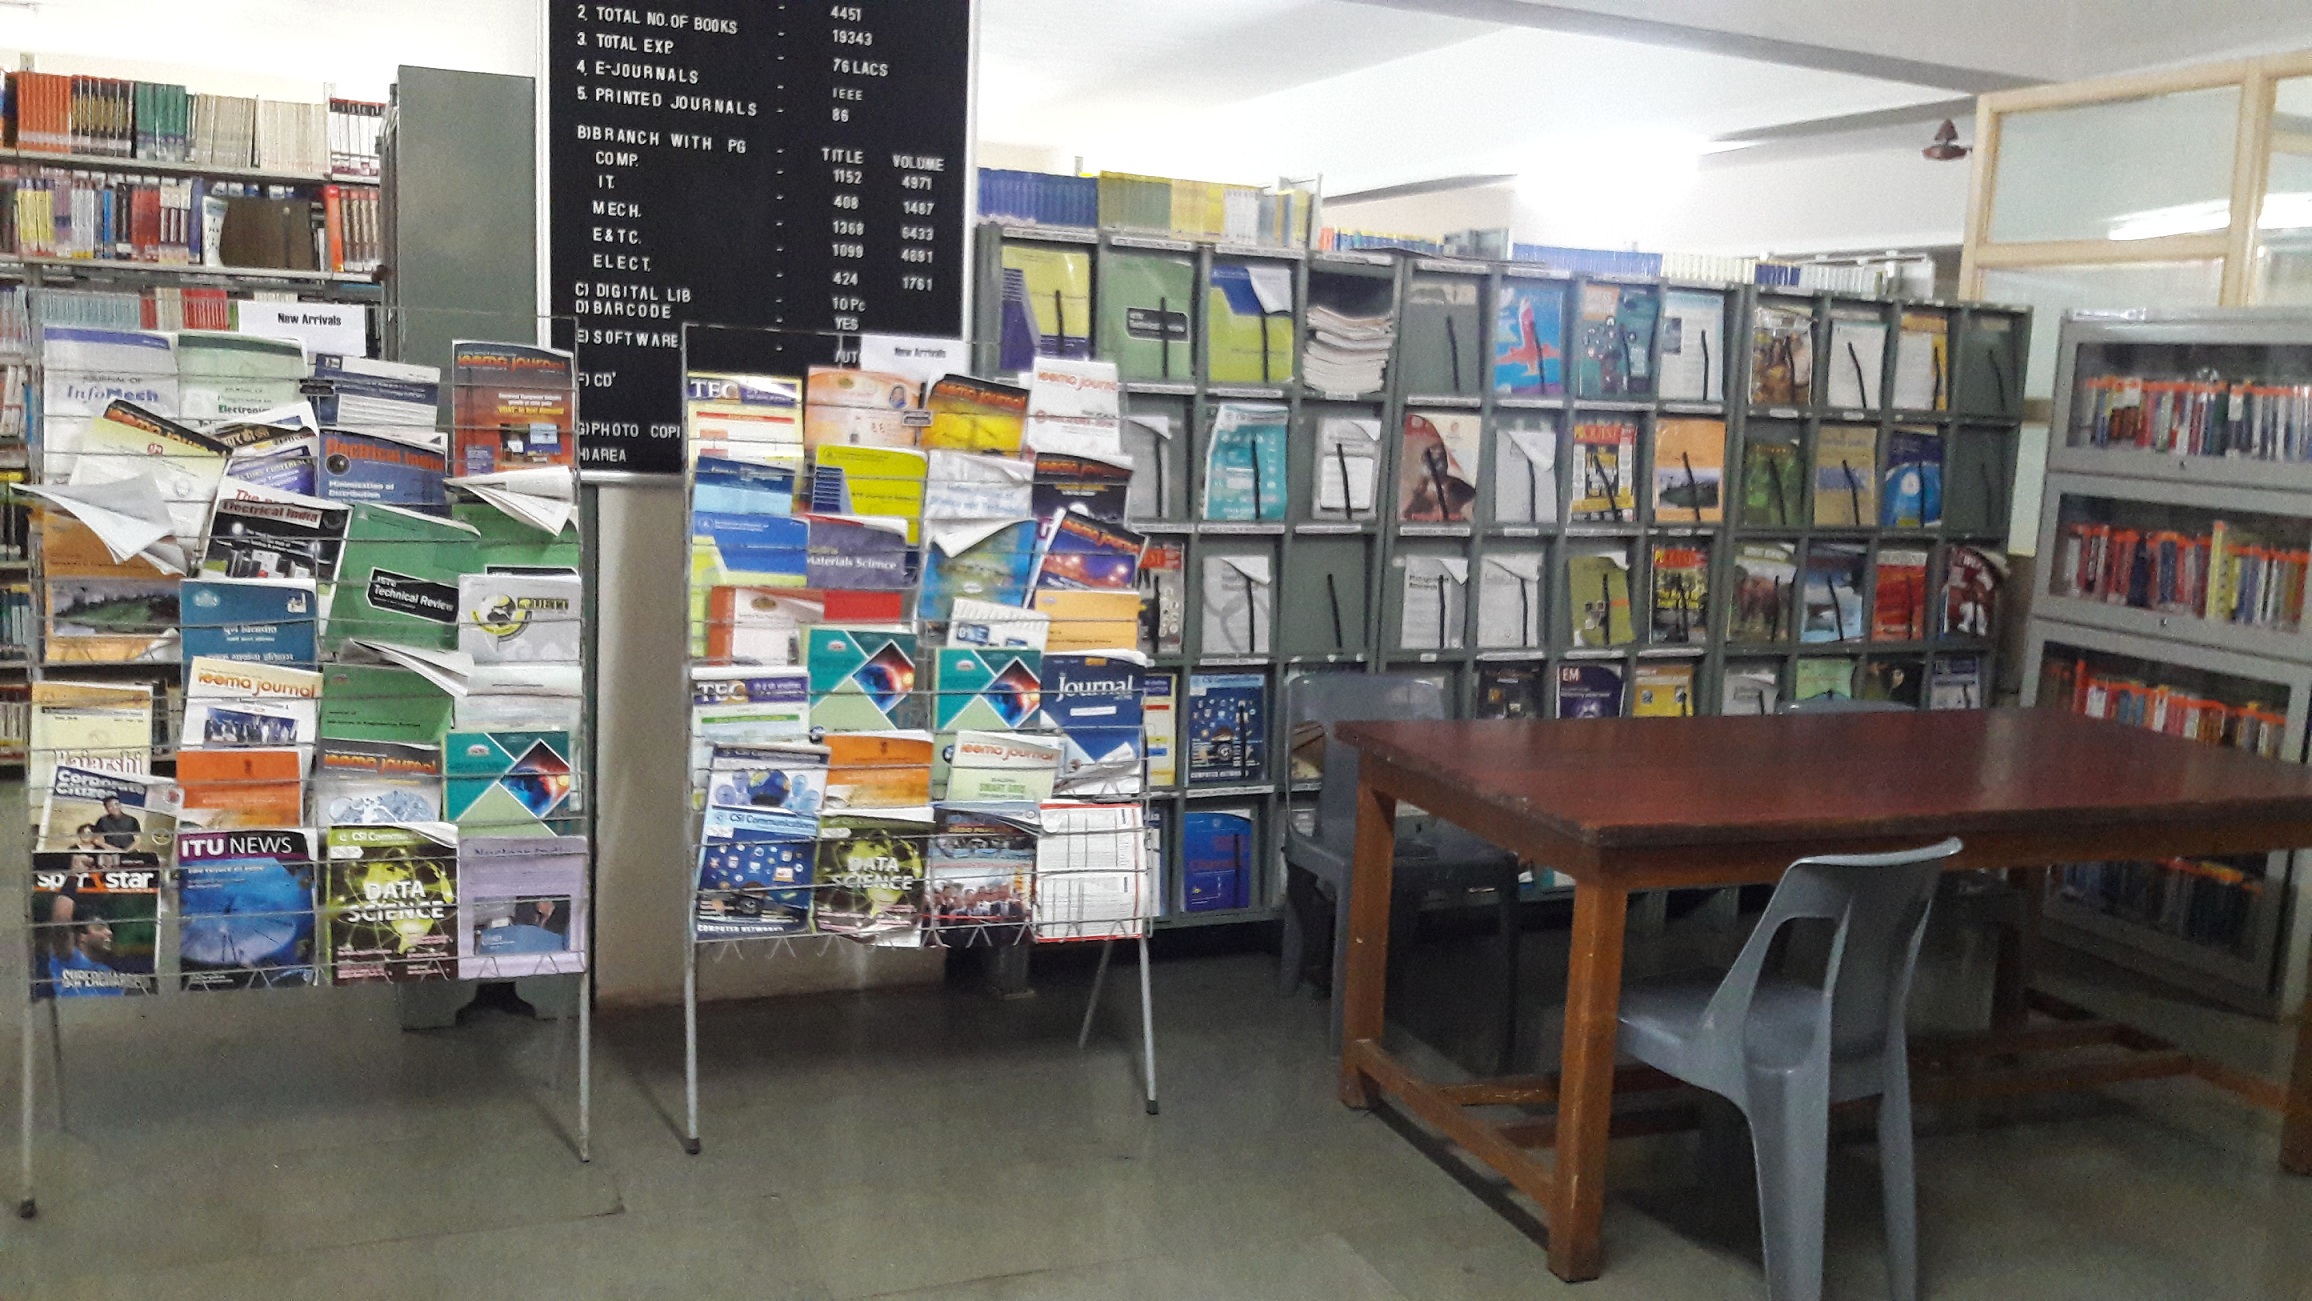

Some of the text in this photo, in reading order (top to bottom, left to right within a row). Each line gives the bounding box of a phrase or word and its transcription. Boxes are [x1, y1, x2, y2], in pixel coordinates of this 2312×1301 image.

[596, 6, 641, 24] TOTAL
[694, 16, 738, 35] BOOKS
[830, 5, 862, 22] 4451
[596, 33, 638, 51] TOTAL
[832, 29, 873, 47] 19343
[595, 60, 699, 85] E-JOURNALS
[852, 60, 889, 77] LACS
[595, 87, 662, 107] PRINTED
[670, 95, 758, 117] JOURNALS
[832, 87, 864, 101] IEEE
[832, 107, 849, 123] 86
[670, 133, 713, 150] WITH
[728, 138, 747, 154] PG
[595, 151, 639, 167] COMP.
[821, 147, 945, 172] TITLE VOLUME
[832, 169, 933, 191] 1152 4971
[592, 200, 642, 218] MECH.
[832, 271, 859, 286] 424
[597, 283, 659, 301] DIGITAL
[667, 287, 692, 303] LIB
[278, 313, 342, 326] New Arrivals
[834, 317, 859, 331] YES
[690, 380, 738, 398] TEC
[374, 584, 454, 612] Technical Review
[1563, 667, 1579, 681] EM
[252, 680, 315, 699] journal
[1056, 674, 1133, 702] Journal
[182, 836, 292, 857] ITU NEWS
[848, 856, 899, 873] DATA
[364, 881, 426, 900] DATA
[830, 872, 913, 892] SCIENCE
[347, 900, 445, 923] SCIENCE
